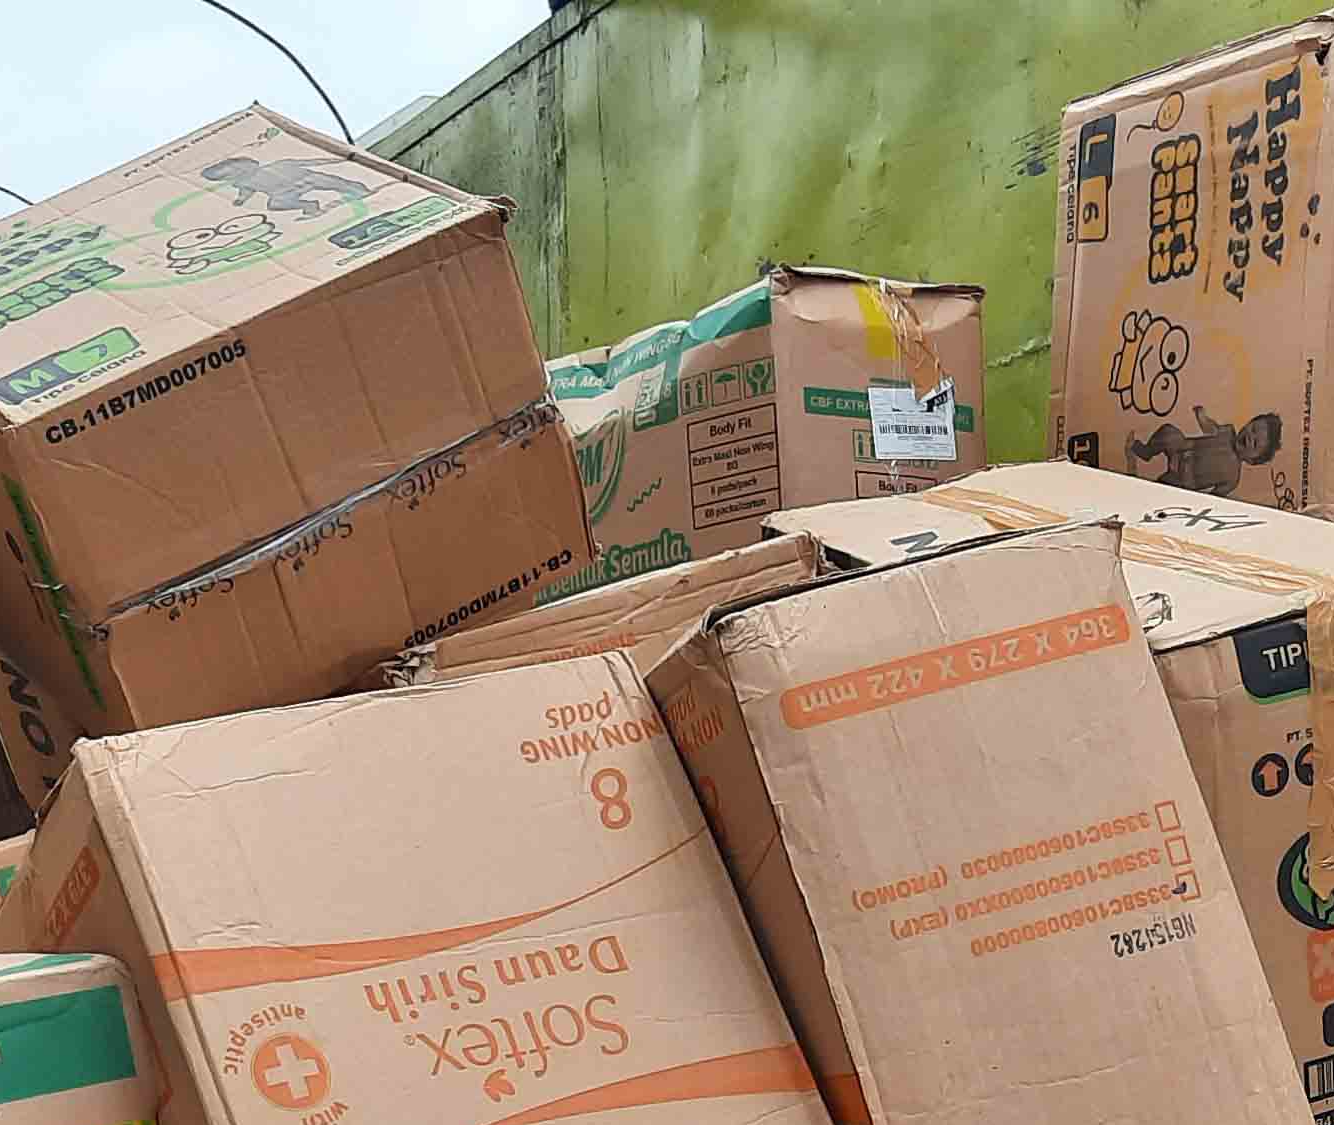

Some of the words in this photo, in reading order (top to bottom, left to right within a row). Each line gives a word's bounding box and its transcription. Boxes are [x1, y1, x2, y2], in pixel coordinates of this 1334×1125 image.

[1263, 65, 1301, 265] Happy
[1082, 202, 1099, 223] 6
[1224, 111, 1263, 302] Nappy
[9, 367, 56, 395] M
[45, 341, 247, 447] CB.11B7MD007005
[710, 422, 735, 437] Body
[738, 417, 752, 430] Fit
[382, 451, 468, 511] Softex
[1065, 612, 1117, 645] 364
[967, 639, 1021, 673] 279
[798, 682, 861, 714] mm
[869, 662, 925, 698] 422
[544, 690, 615, 733] pads
[595, 706, 670, 750] NON
[520, 718, 593, 765] WING
[590, 766, 632, 830] 8
[850, 866, 949, 914] (PROMO)
[498, 935, 630, 987] Daun
[364, 956, 489, 1024] Sirih
[223, 1002, 306, 1076] antiseptic
[424, 992, 630, 1080] Softex
